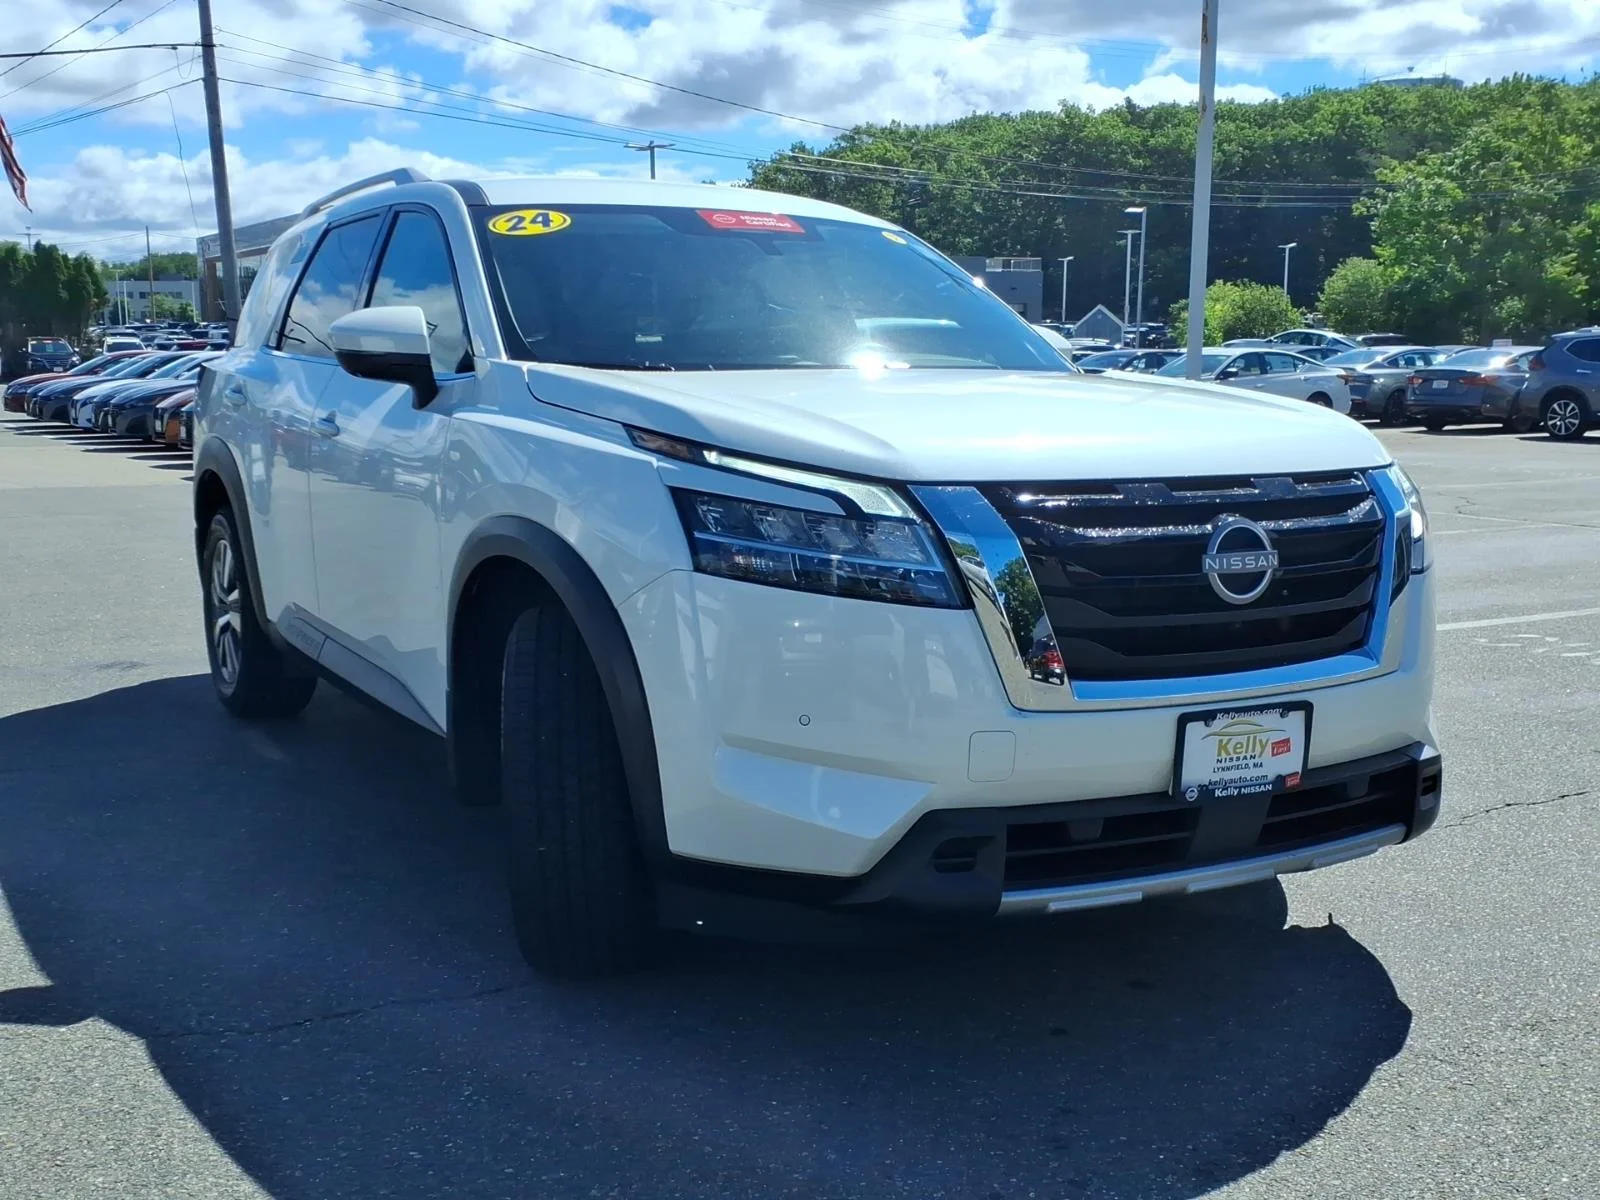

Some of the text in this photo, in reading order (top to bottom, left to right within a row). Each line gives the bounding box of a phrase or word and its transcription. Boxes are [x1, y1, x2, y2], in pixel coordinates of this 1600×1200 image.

[504, 212, 554, 232] 24
[1205, 554, 1278, 570] NISSAN
[1216, 735, 1269, 758] Kelly
[1216, 754, 1257, 764] NISSAN
[1212, 761, 1264, 774] LYNNFIELD, MA
[1208, 774, 1269, 787] kellyauto.com
[1214, 783, 1273, 797] Kelly NISSAN
